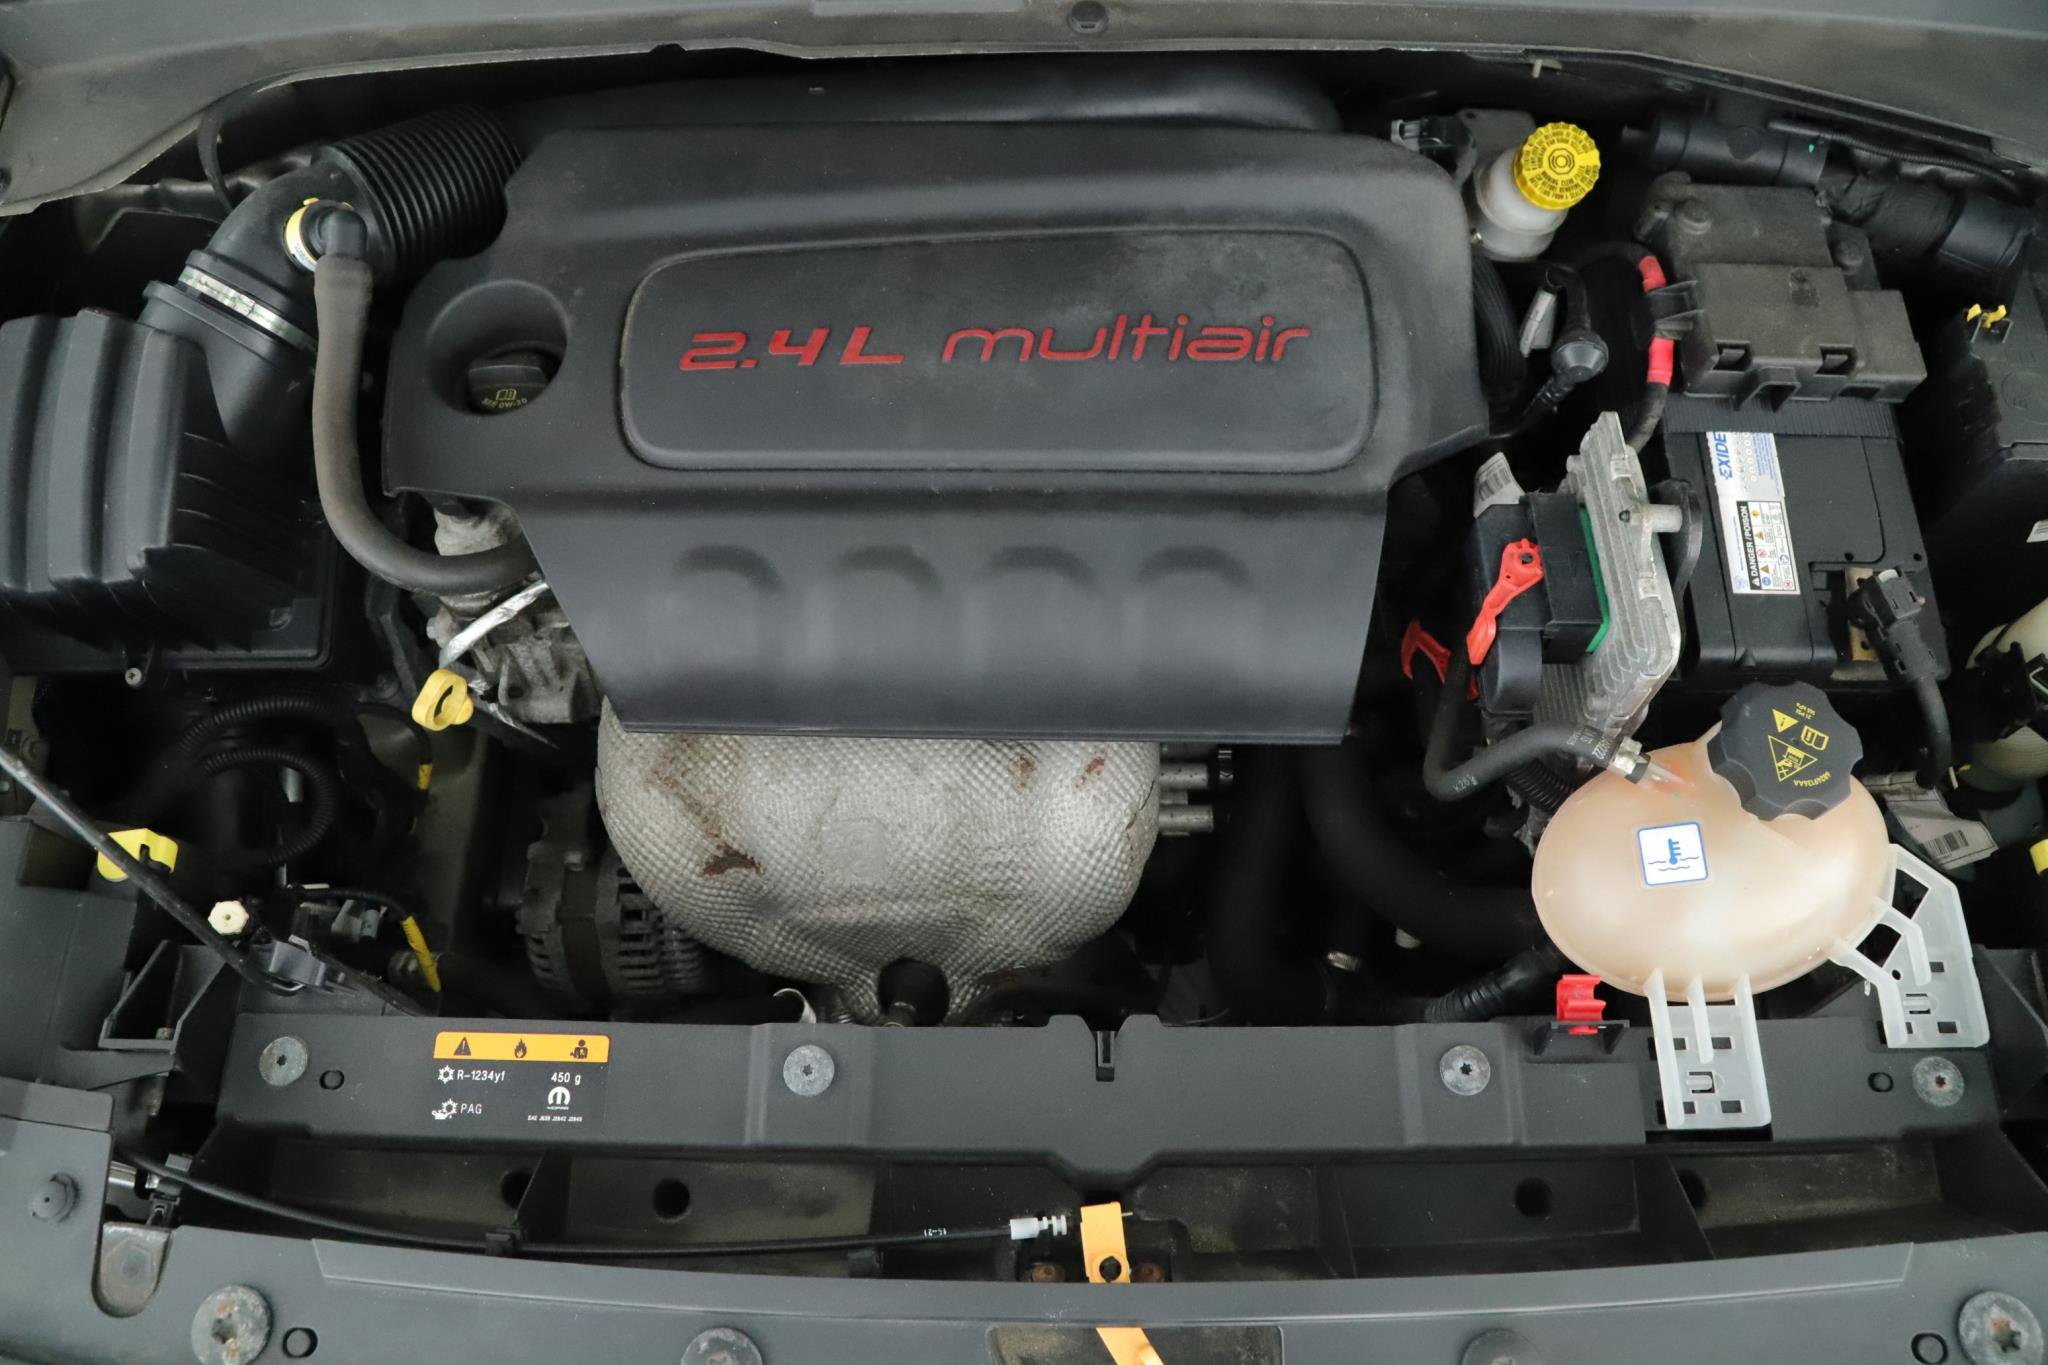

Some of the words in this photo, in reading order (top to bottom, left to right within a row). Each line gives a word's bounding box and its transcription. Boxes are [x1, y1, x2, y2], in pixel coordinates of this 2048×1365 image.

[680, 327, 904, 371] 2.4L
[942, 314, 1311, 363] multiair
[1712, 432, 1733, 479] EXIDE
[1745, 541, 1760, 577] DANGER
[457, 1069, 506, 1084] R-1234yf
[551, 1072, 571, 1083] 450
[574, 1074, 582, 1086] g
[460, 1103, 483, 1115] PAG
